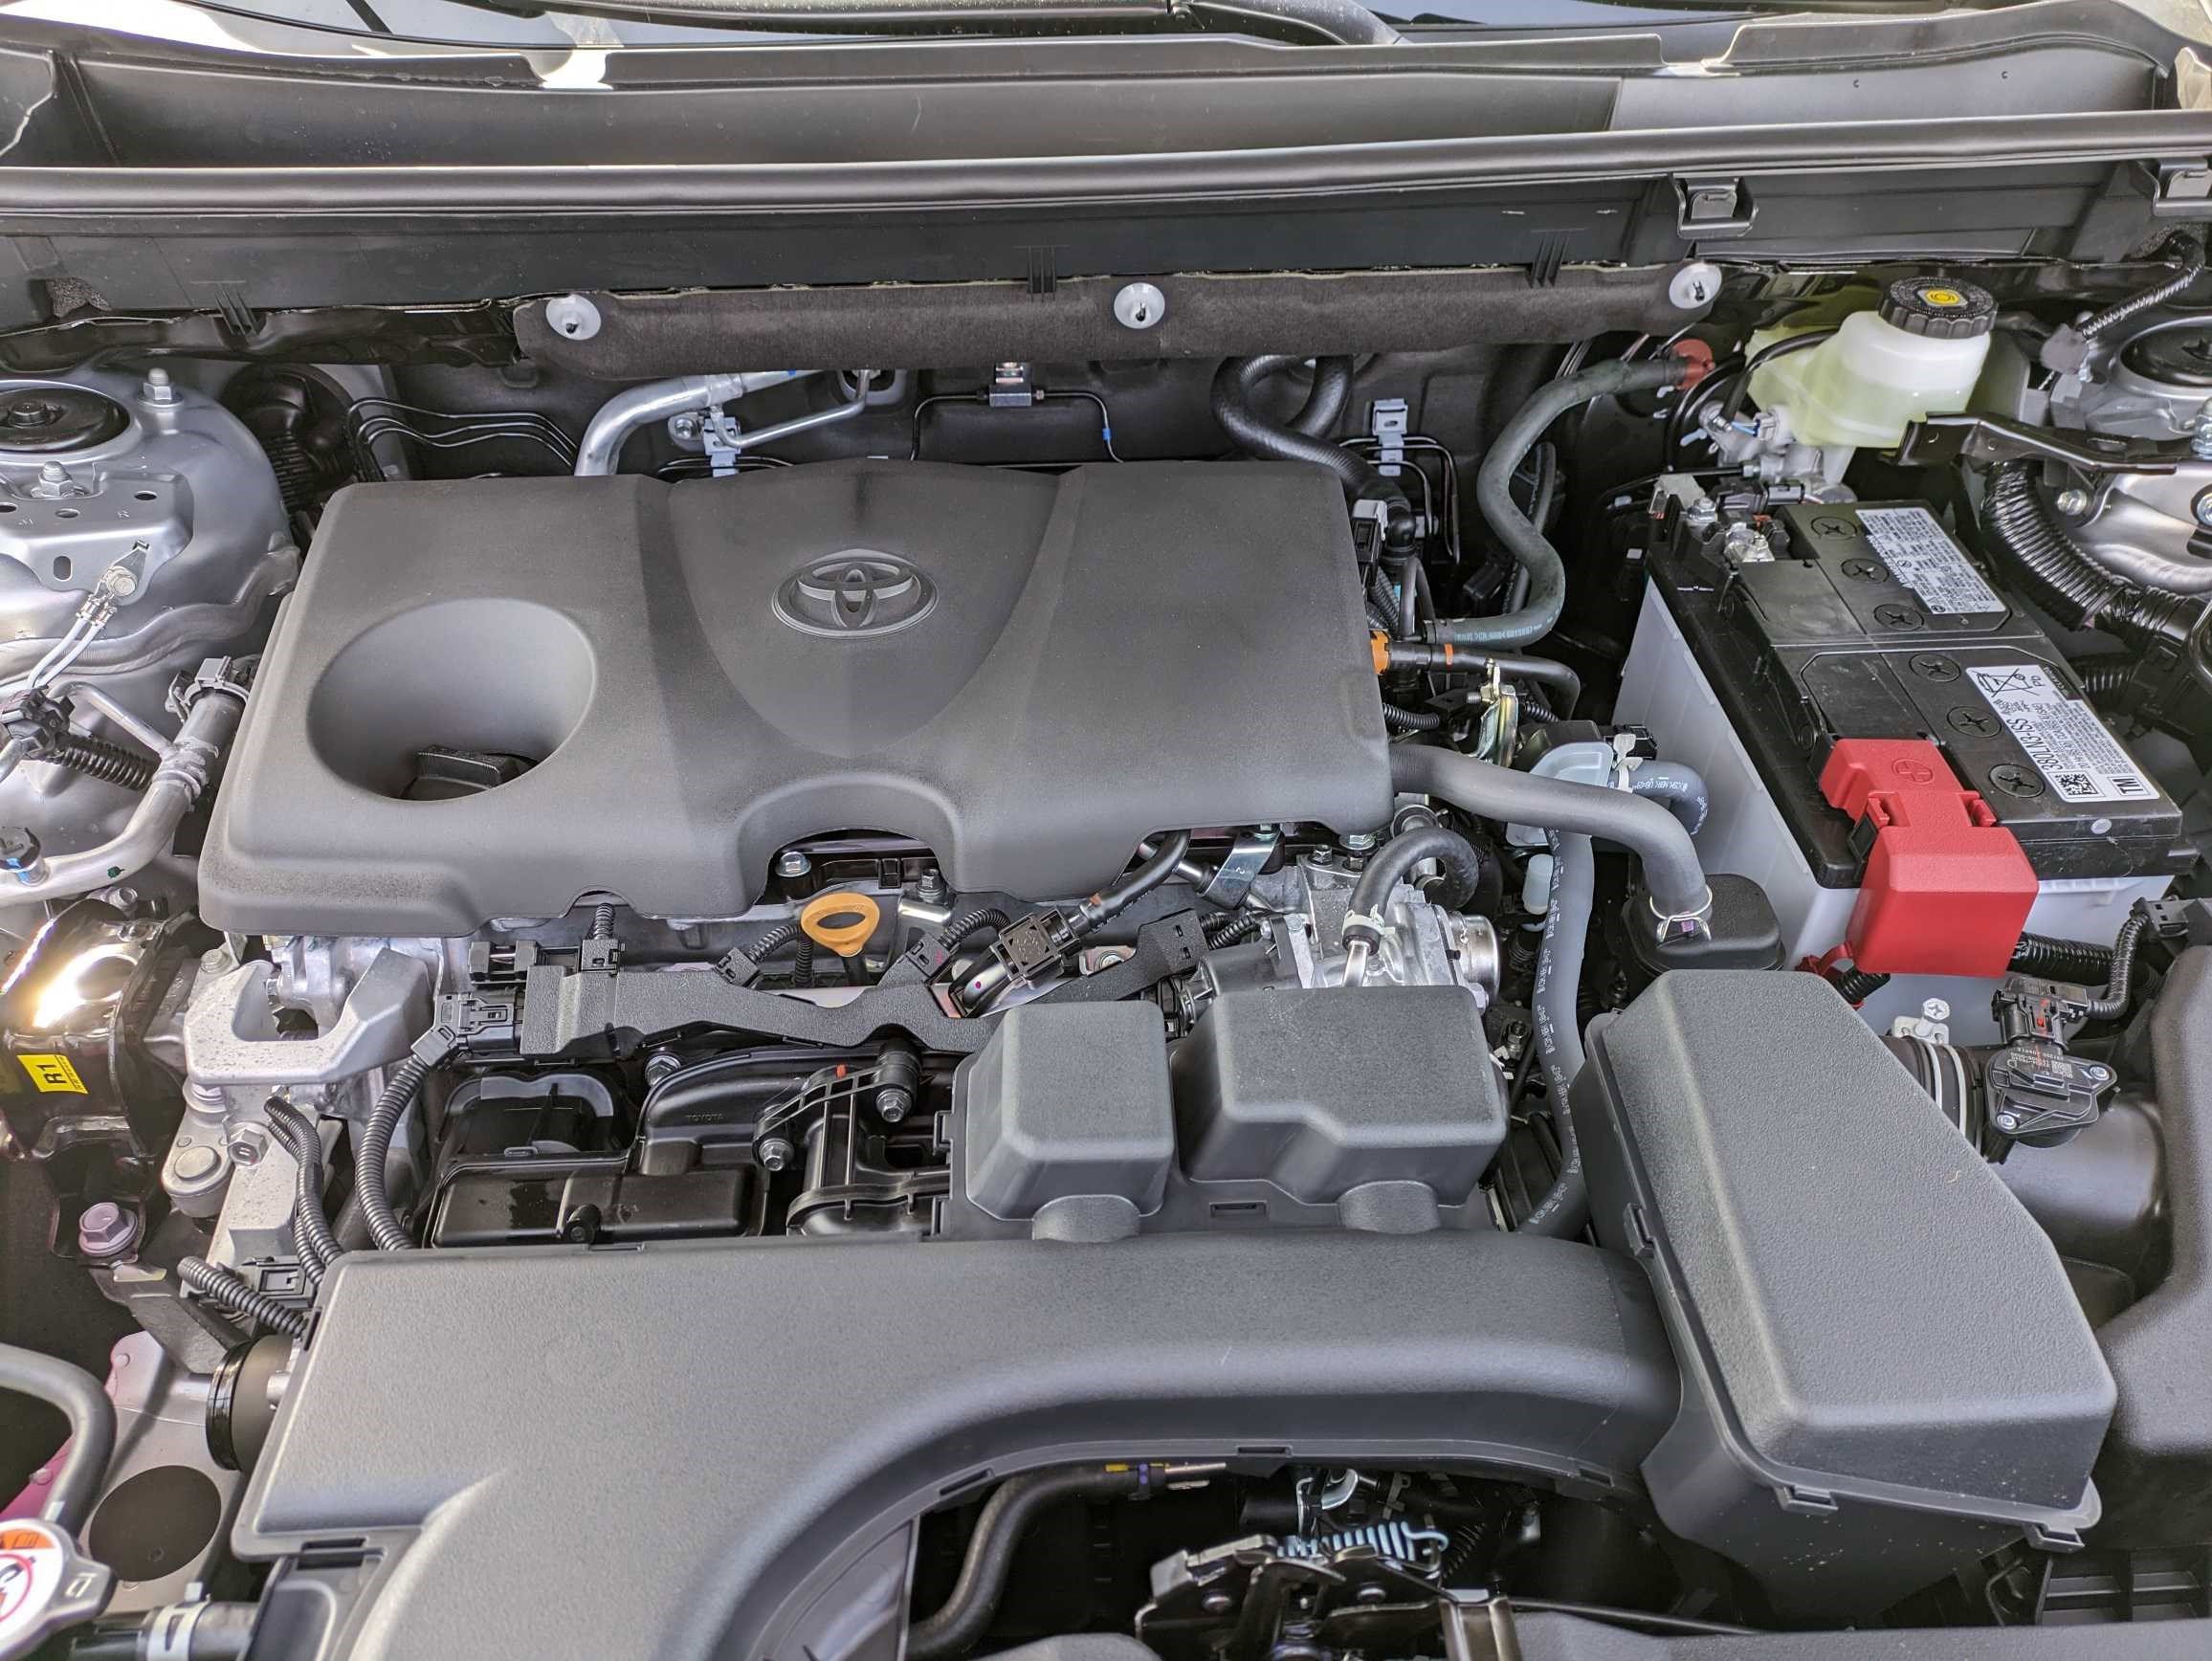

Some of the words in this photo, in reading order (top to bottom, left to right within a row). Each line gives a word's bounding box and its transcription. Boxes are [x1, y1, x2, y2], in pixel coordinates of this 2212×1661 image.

[2029, 675, 2046, 686] Pb
[2005, 718, 2064, 770] 380LN3-ISS
[2113, 778, 2145, 793] TM
[36, 1064, 67, 1083] R1
[686, 1113, 725, 1122] TOYOTA
